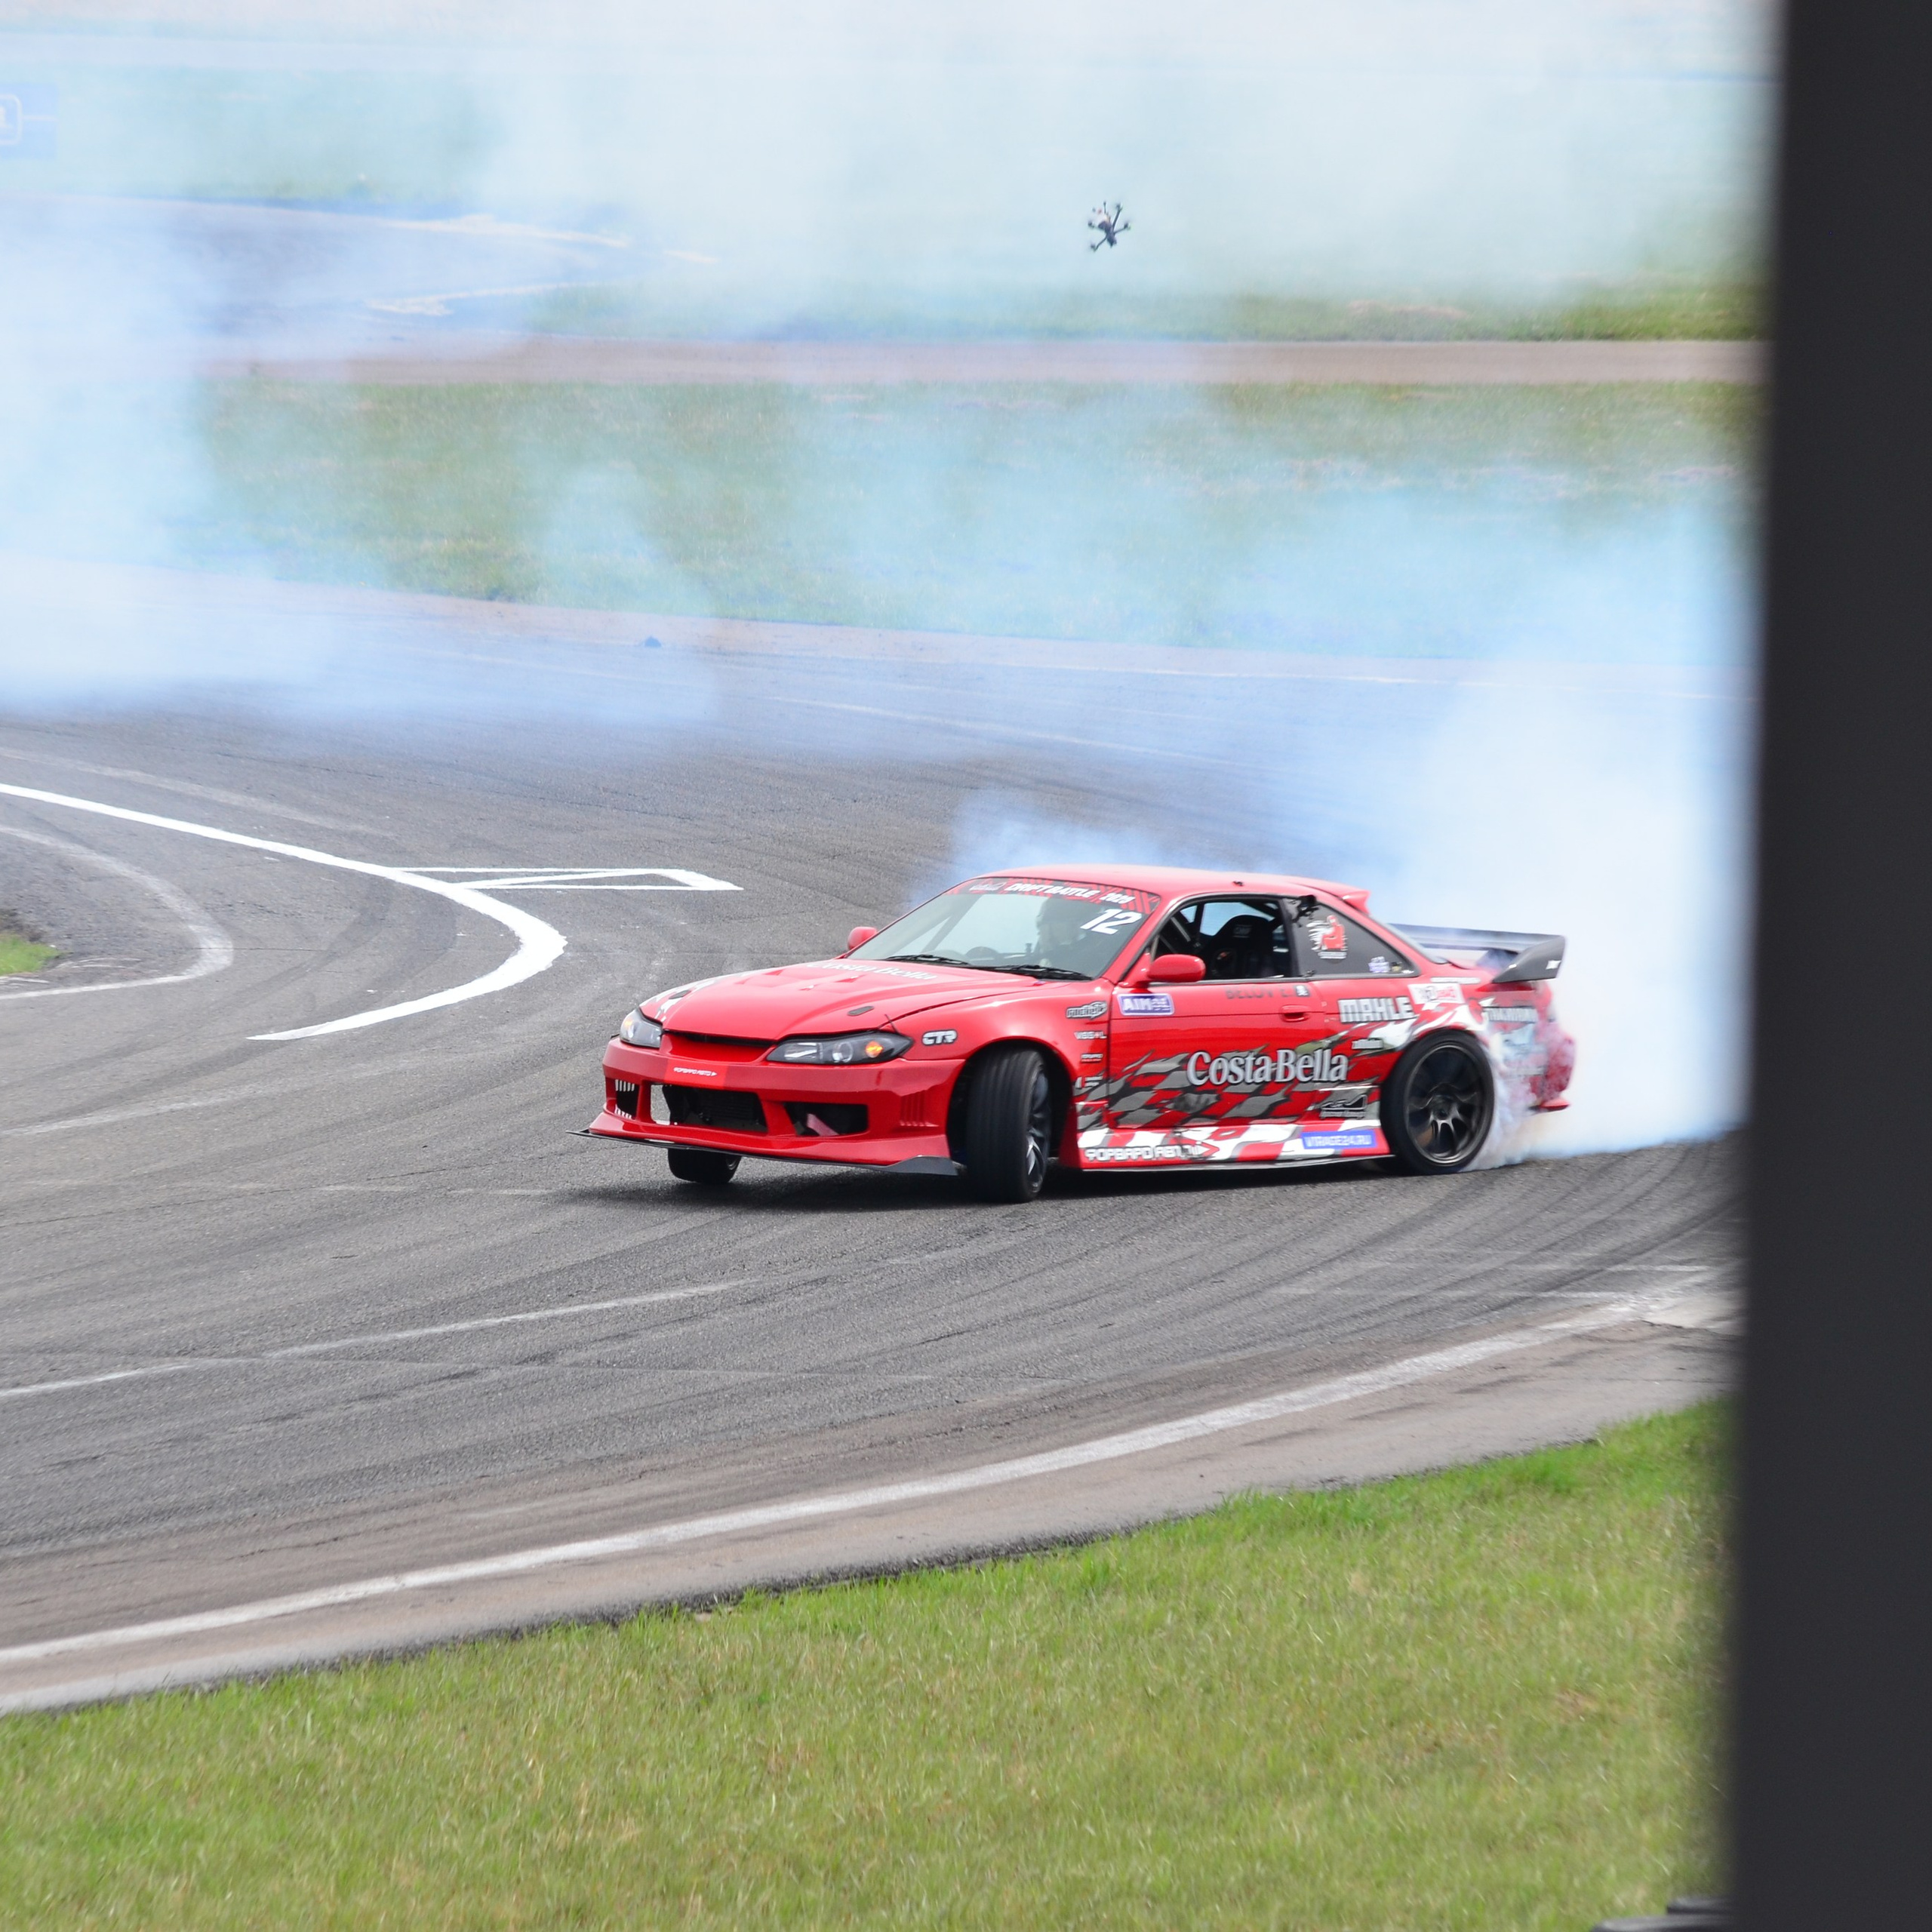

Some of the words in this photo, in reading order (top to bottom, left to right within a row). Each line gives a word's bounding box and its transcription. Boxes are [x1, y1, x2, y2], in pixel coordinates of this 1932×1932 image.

[1044, 885, 1100, 898] BATTLE
[1080, 908, 1142, 935] 12
[1338, 997, 1415, 1023] MAHLE
